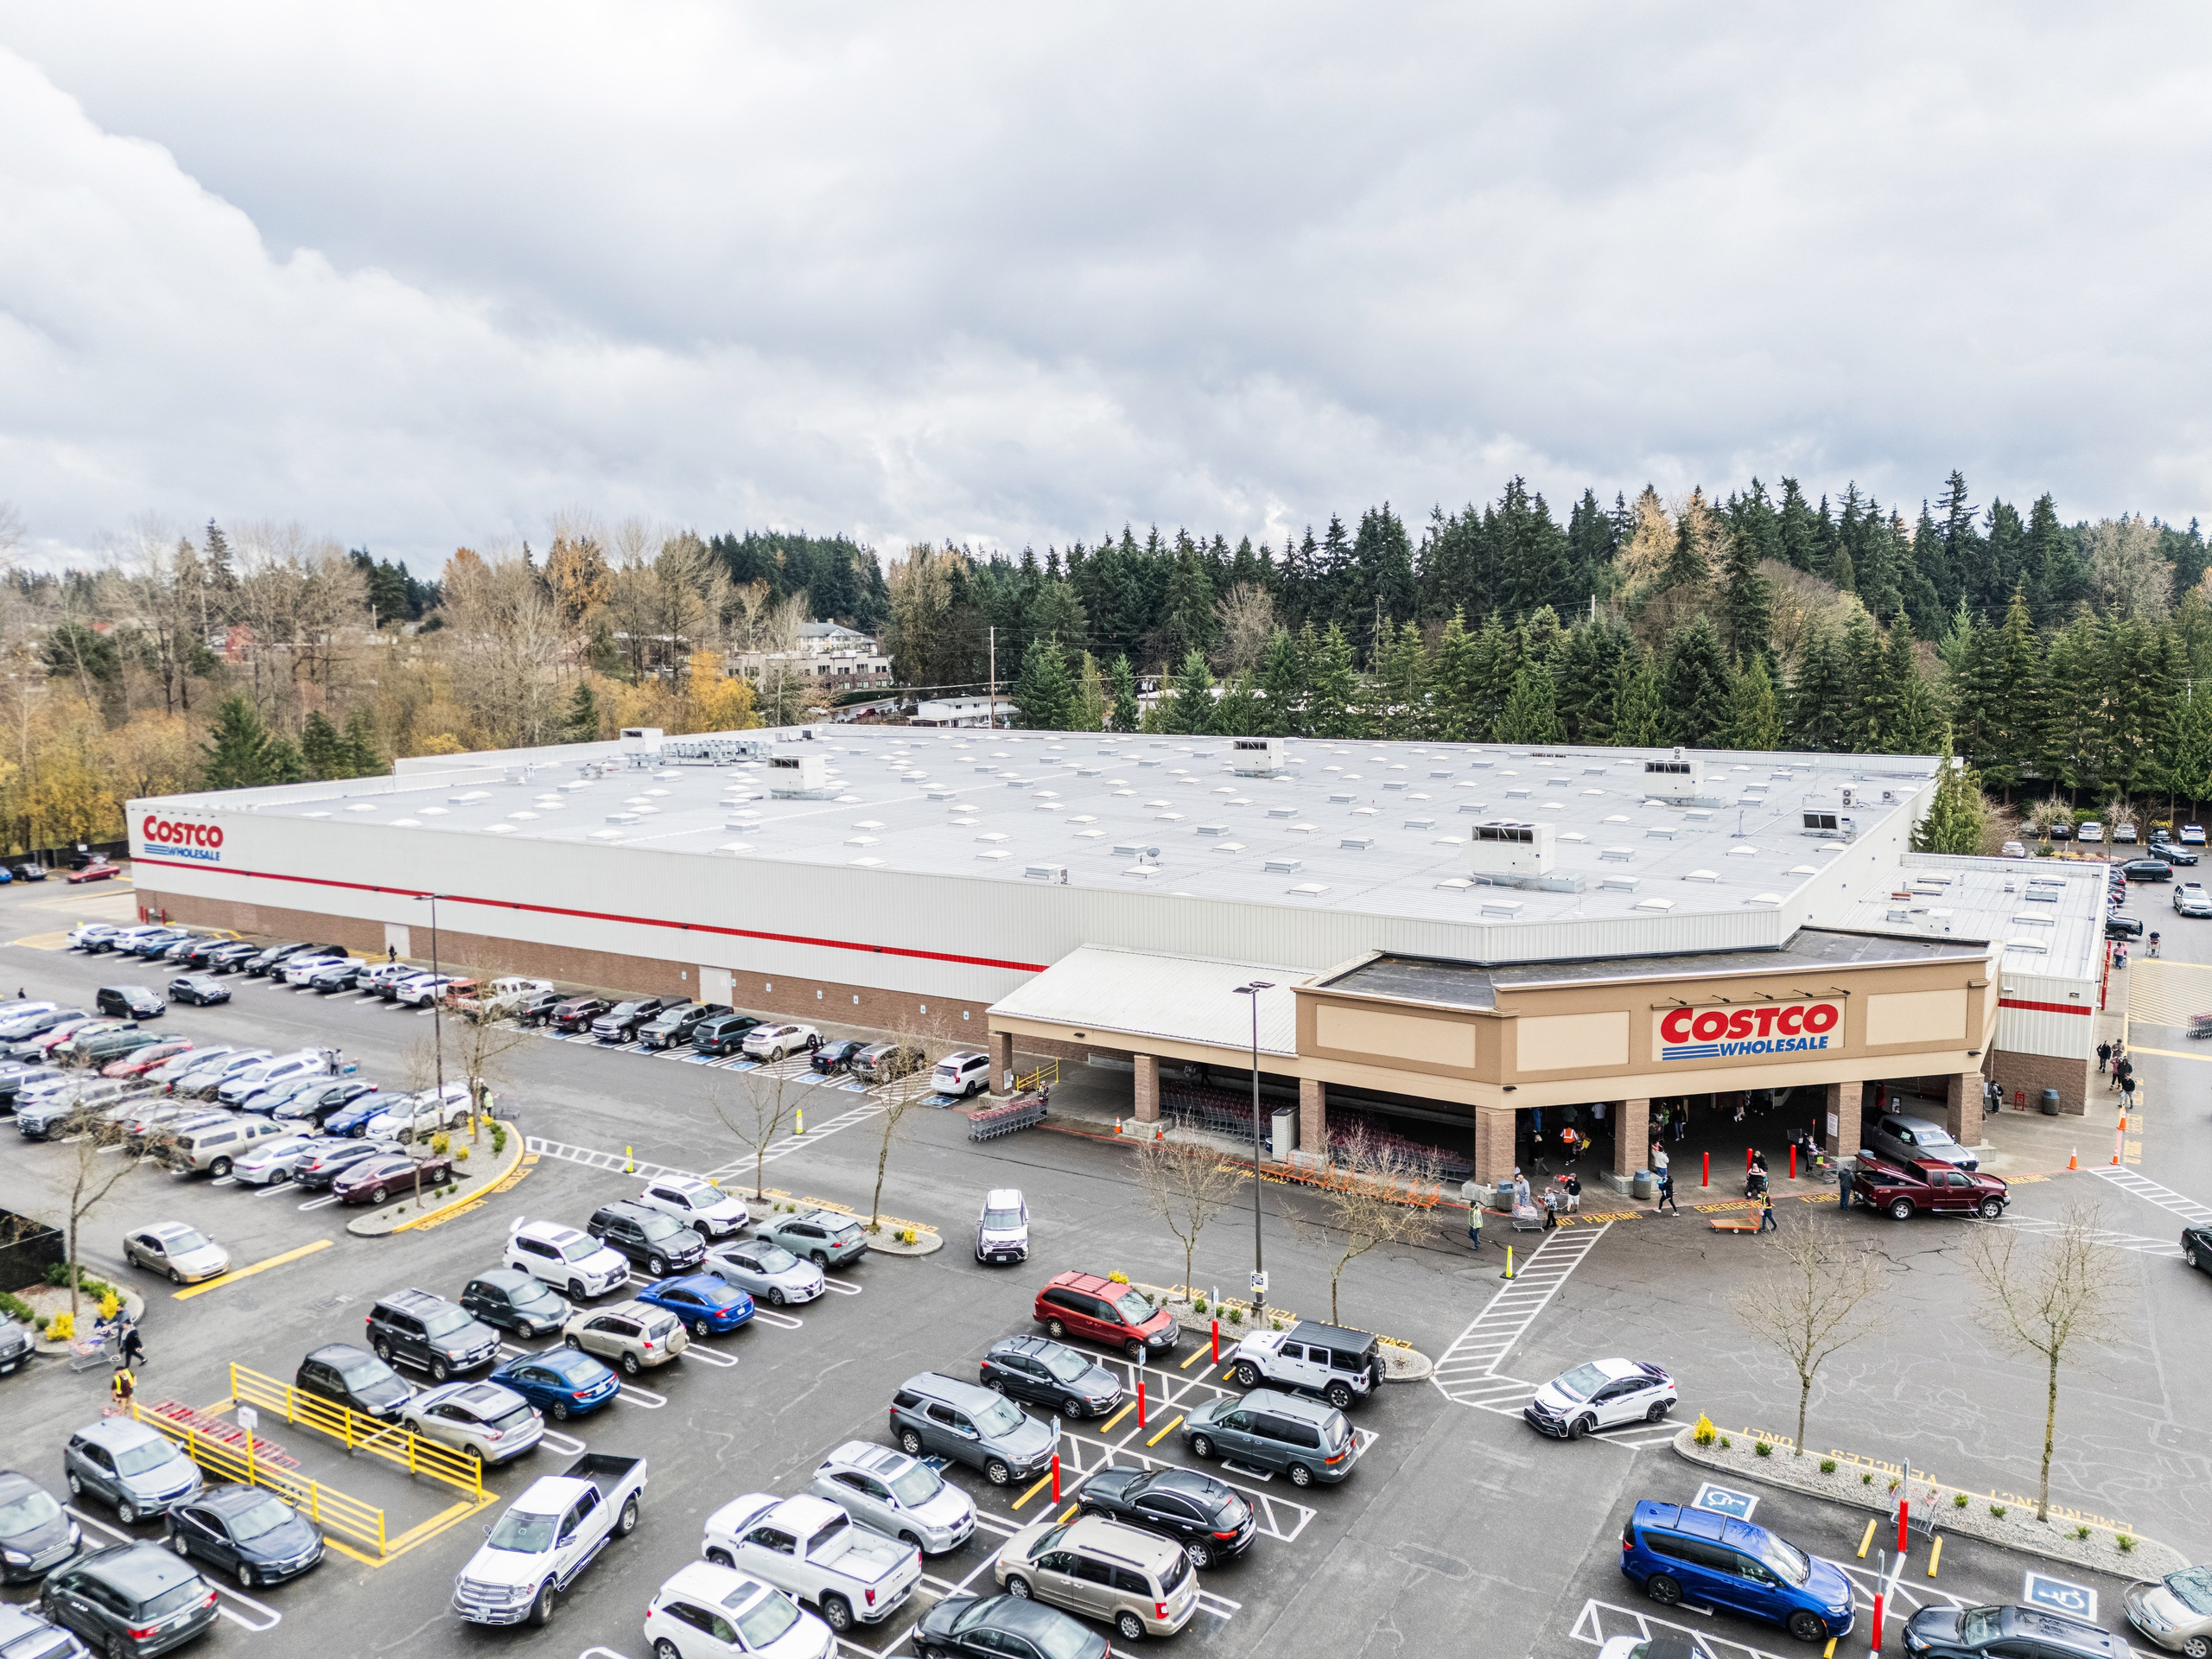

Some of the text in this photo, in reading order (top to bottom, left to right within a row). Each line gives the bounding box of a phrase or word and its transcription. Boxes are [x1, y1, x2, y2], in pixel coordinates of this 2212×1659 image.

[143, 815, 224, 849] COSTCO
[167, 847, 220, 861] WHOLESALE
[1661, 1003, 1839, 1044] COSTCO
[1719, 1035, 1829, 1057] WHOLESALE
[1555, 1211, 1643, 1227] NO PARKING
[1167, 1283, 1208, 1300] ONLY
[1741, 1427, 1794, 1447] ONLY
